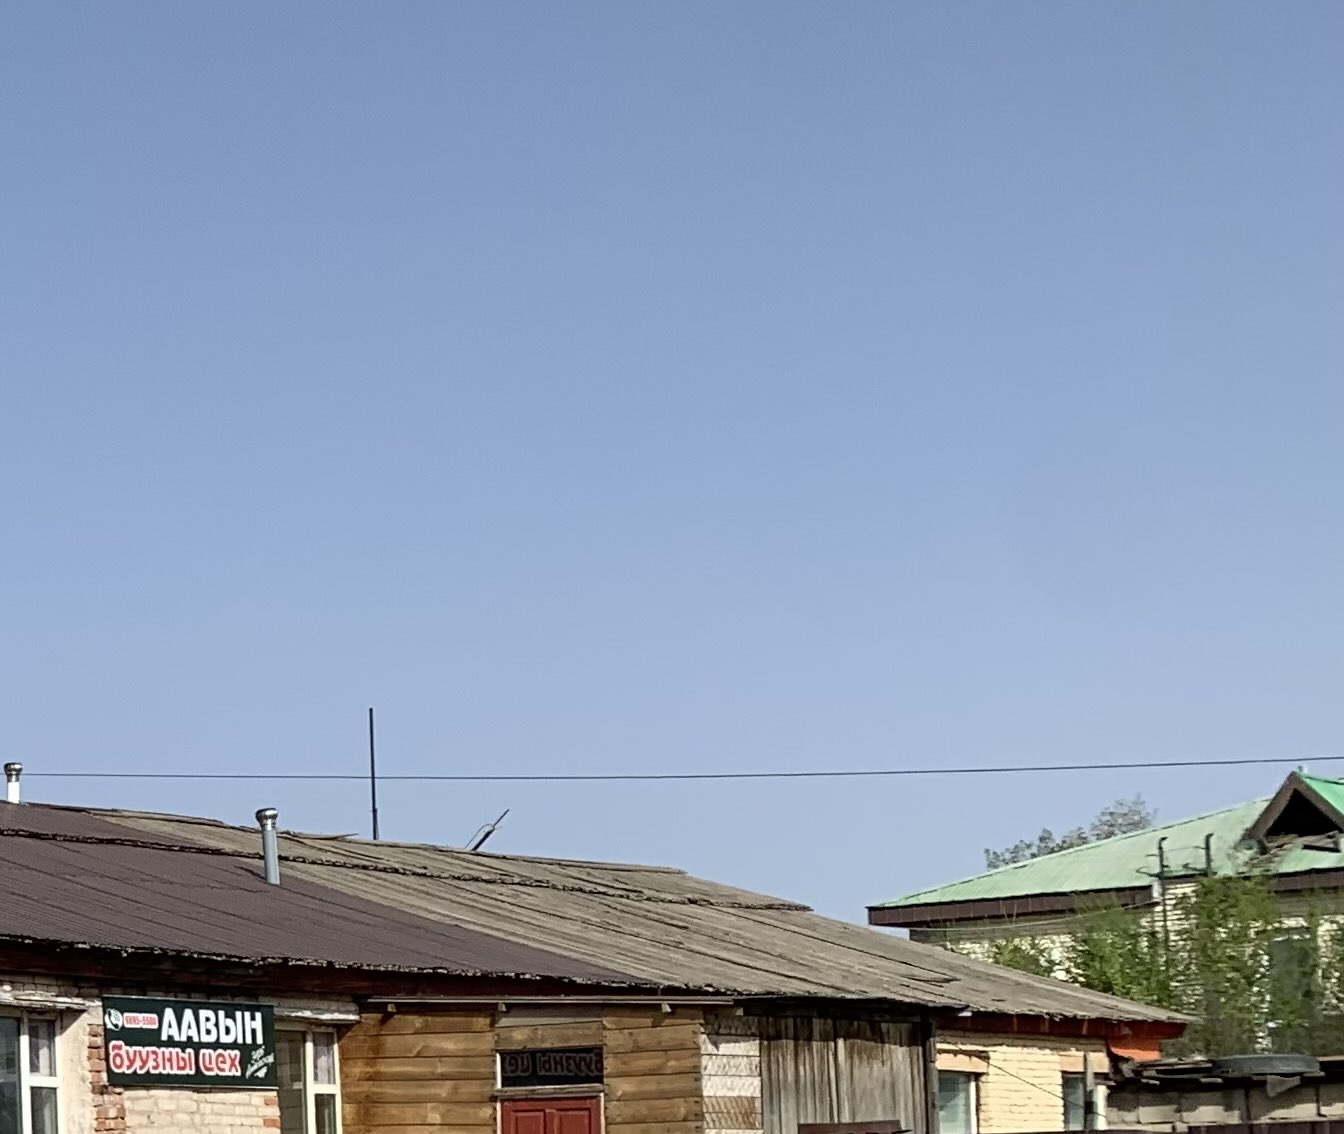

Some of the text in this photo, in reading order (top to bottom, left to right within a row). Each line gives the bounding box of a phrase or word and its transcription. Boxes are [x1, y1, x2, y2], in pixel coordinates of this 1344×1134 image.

[161, 1007, 263, 1045] ААВЫН
[111, 1042, 193, 1073] буузны
[201, 1051, 241, 1075] цех
